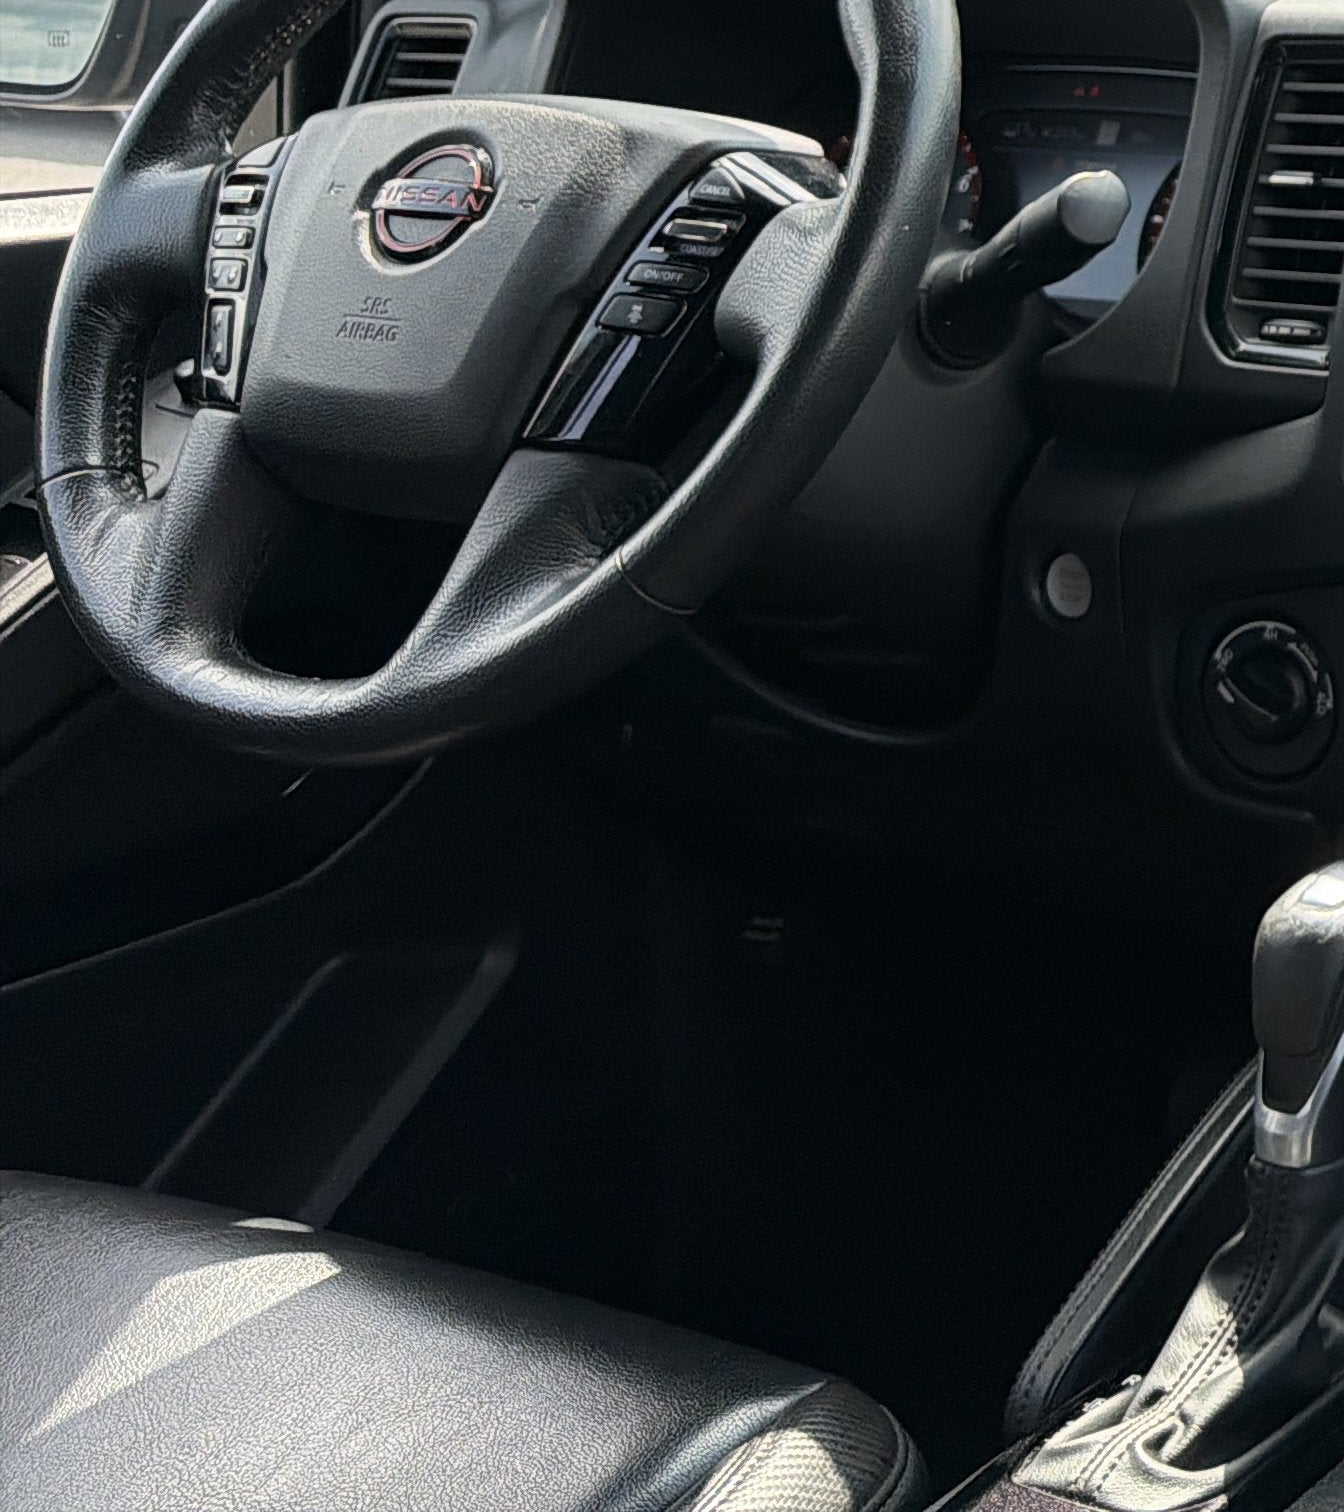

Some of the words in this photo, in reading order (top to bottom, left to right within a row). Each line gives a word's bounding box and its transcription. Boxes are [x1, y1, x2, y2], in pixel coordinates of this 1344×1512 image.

[375, 185, 487, 212] NISSAN
[699, 183, 730, 196] CANCEL
[643, 269, 684, 282] ON/OFF
[361, 297, 393, 315] SRS
[336, 320, 400, 343] AIRBAG
